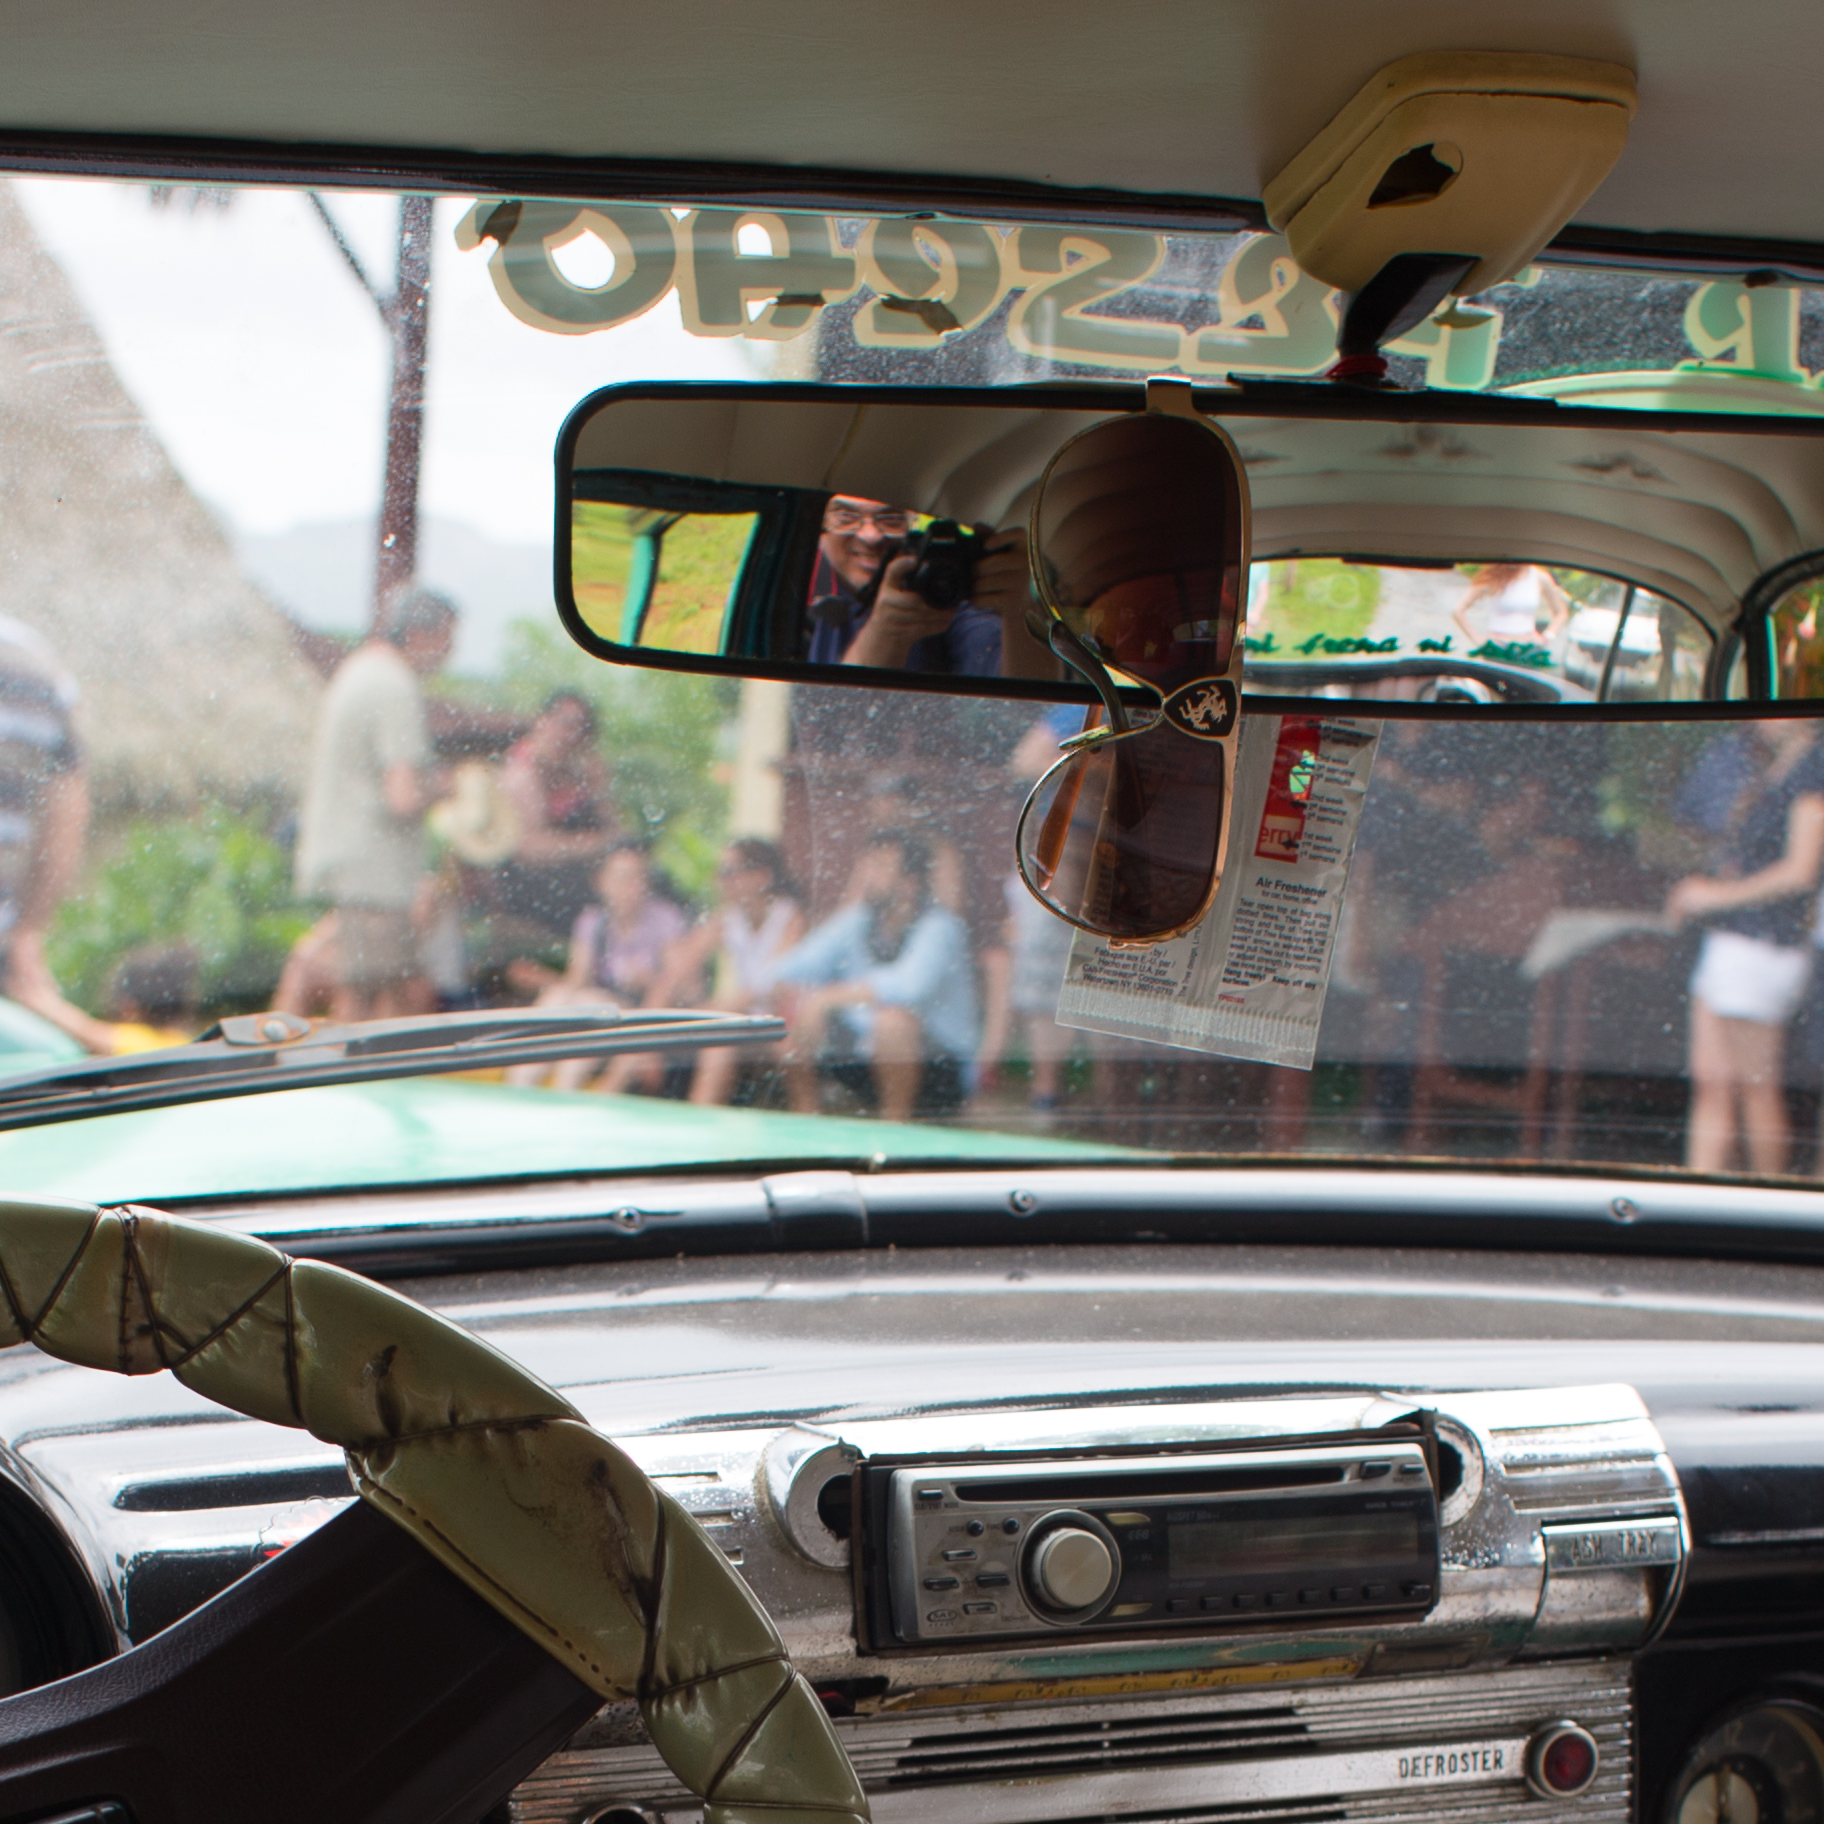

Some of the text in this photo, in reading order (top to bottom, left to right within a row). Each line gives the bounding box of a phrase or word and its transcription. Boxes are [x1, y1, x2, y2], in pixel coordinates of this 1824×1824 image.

[1256, 876, 1328, 898] Air Freshener
[1572, 1529, 1656, 1560] ASH TRAY
[1398, 1749, 1504, 1779] DEFROSTER
